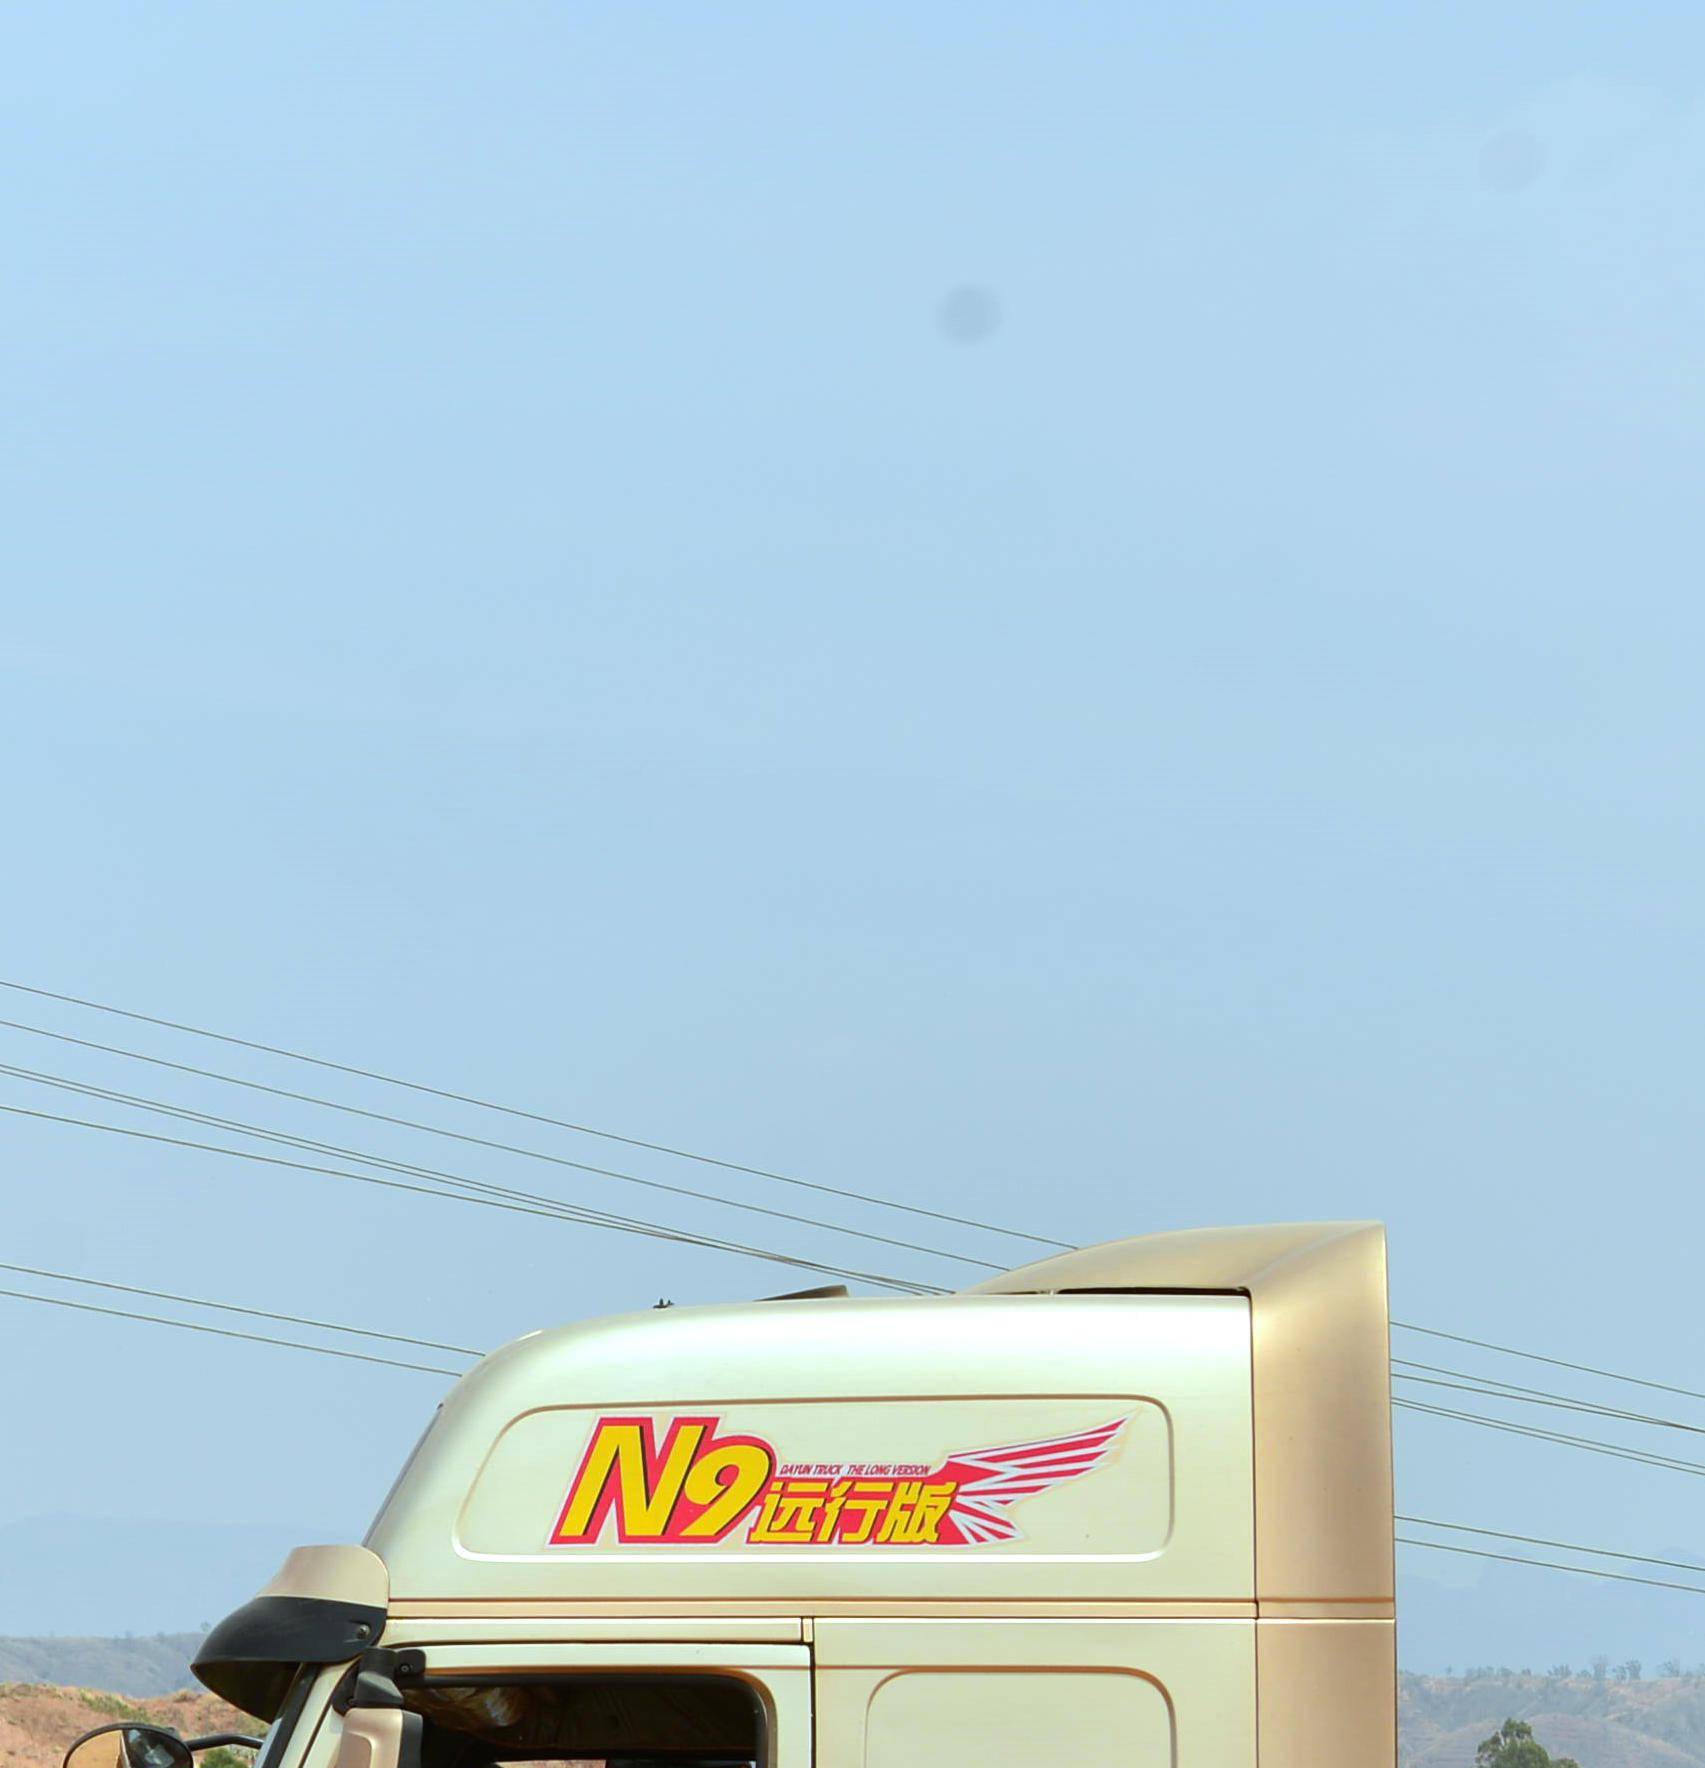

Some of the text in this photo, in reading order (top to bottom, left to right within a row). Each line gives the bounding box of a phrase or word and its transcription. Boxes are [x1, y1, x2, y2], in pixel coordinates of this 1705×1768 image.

[557, 1422, 775, 1538] N9
[780, 1464, 932, 1476] DAYUN TRUCK THE LONG VERSION
[749, 1481, 958, 1543] 远行版
